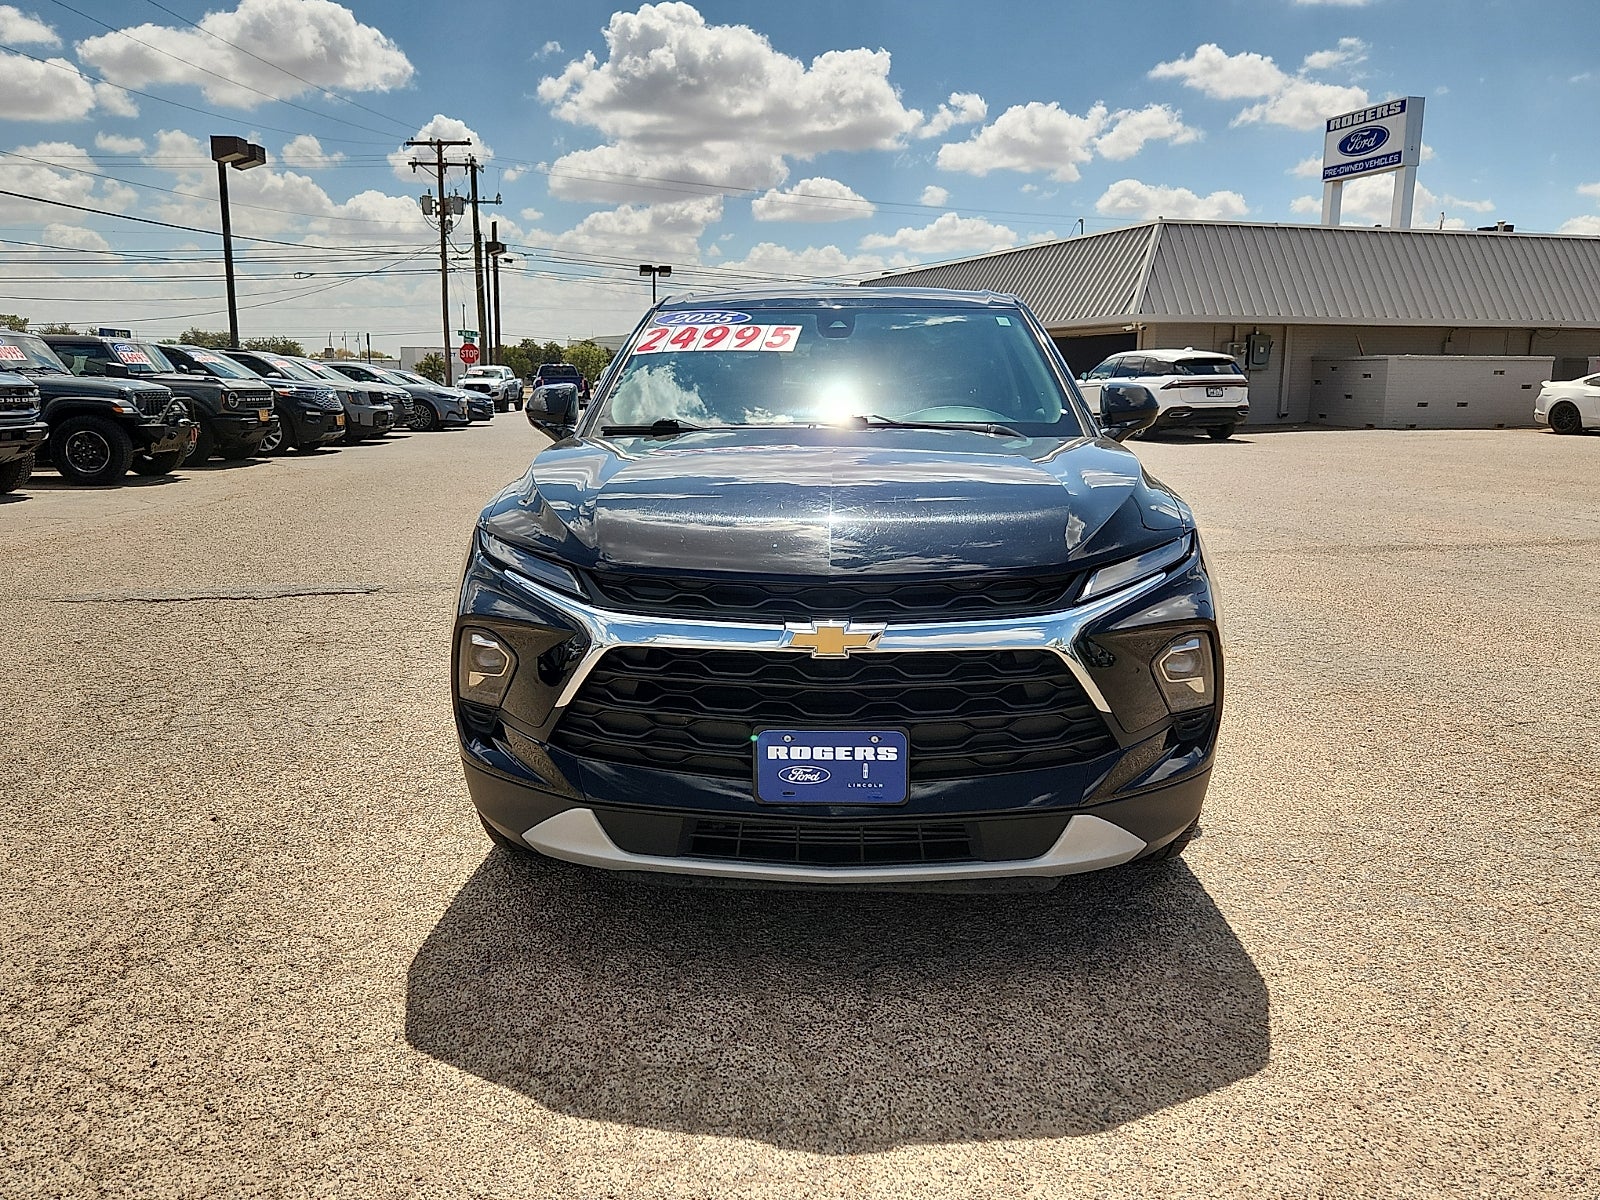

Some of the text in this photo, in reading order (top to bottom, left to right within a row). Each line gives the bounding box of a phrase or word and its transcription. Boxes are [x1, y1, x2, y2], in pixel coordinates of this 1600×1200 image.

[1329, 101, 1402, 130] ROGERS
[1346, 130, 1378, 152] Ford
[1324, 154, 1399, 177] PRE-OWNED VEHICLES
[671, 312, 735, 324] 2025
[636, 325, 797, 352] 24995
[460, 349, 478, 360] STOP
[767, 745, 898, 761] ROGERS
[788, 766, 820, 782] Ford
